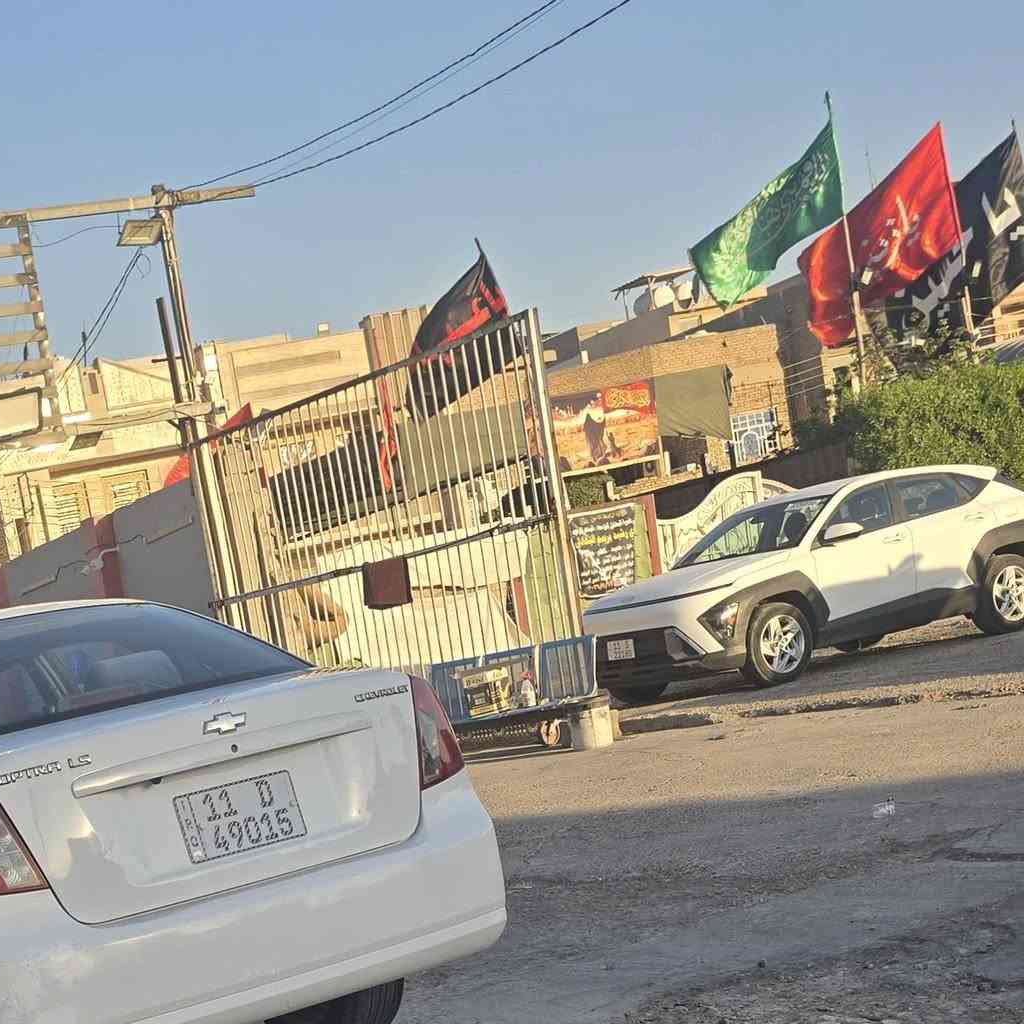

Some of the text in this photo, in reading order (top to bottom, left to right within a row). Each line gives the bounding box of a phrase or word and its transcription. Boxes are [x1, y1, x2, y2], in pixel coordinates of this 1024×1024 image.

[67, 754, 93, 769] LS
[202, 779, 274, 822] 11 D
[214, 807, 295, 851] 49015
